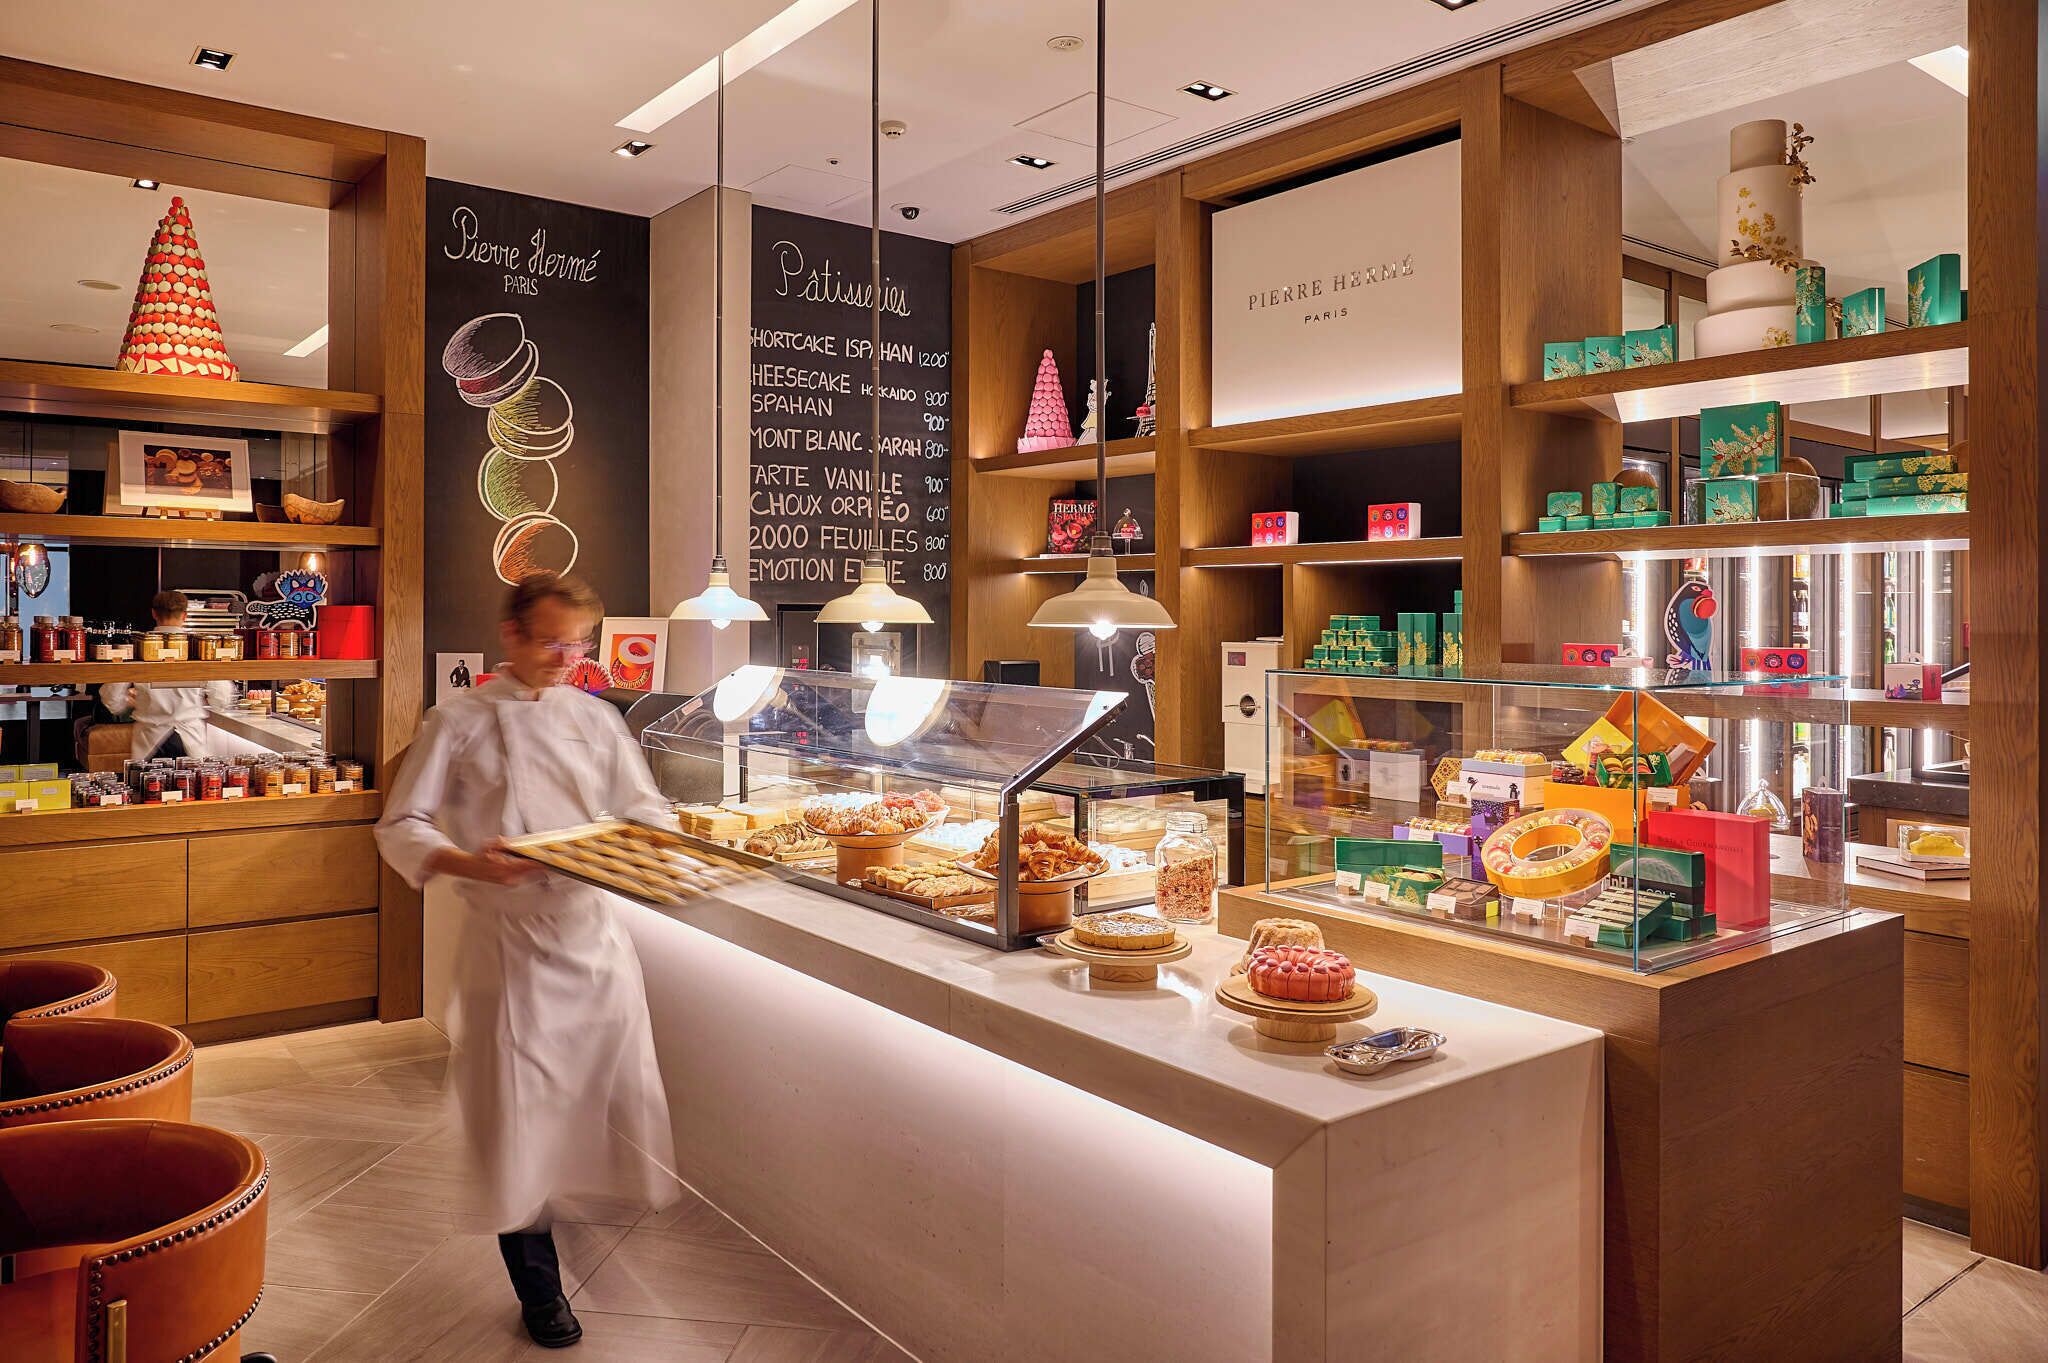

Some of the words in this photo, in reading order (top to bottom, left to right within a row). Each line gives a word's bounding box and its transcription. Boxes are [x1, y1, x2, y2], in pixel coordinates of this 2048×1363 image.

[445, 206, 520, 270] Pierre
[528, 228, 601, 282] Hermé
[503, 274, 539, 295] PARIS
[1248, 279, 1323, 311] PIERRE
[1332, 253, 1415, 292] HERMÉ
[1303, 307, 1348, 324] PARIS
[750, 363, 851, 394] HEESECAKE
[751, 393, 833, 417] SPAHAN
[750, 427, 802, 450] MONT
[806, 429, 863, 451] BLANC
[824, 466, 903, 495] VANILE
[750, 491, 823, 516] CHOUX
[1053, 502, 1095, 514] HERMÉ
[750, 524, 809, 550] 2000
[749, 558, 834, 582] EMOTION
[844, 557, 906, 584] EIE
